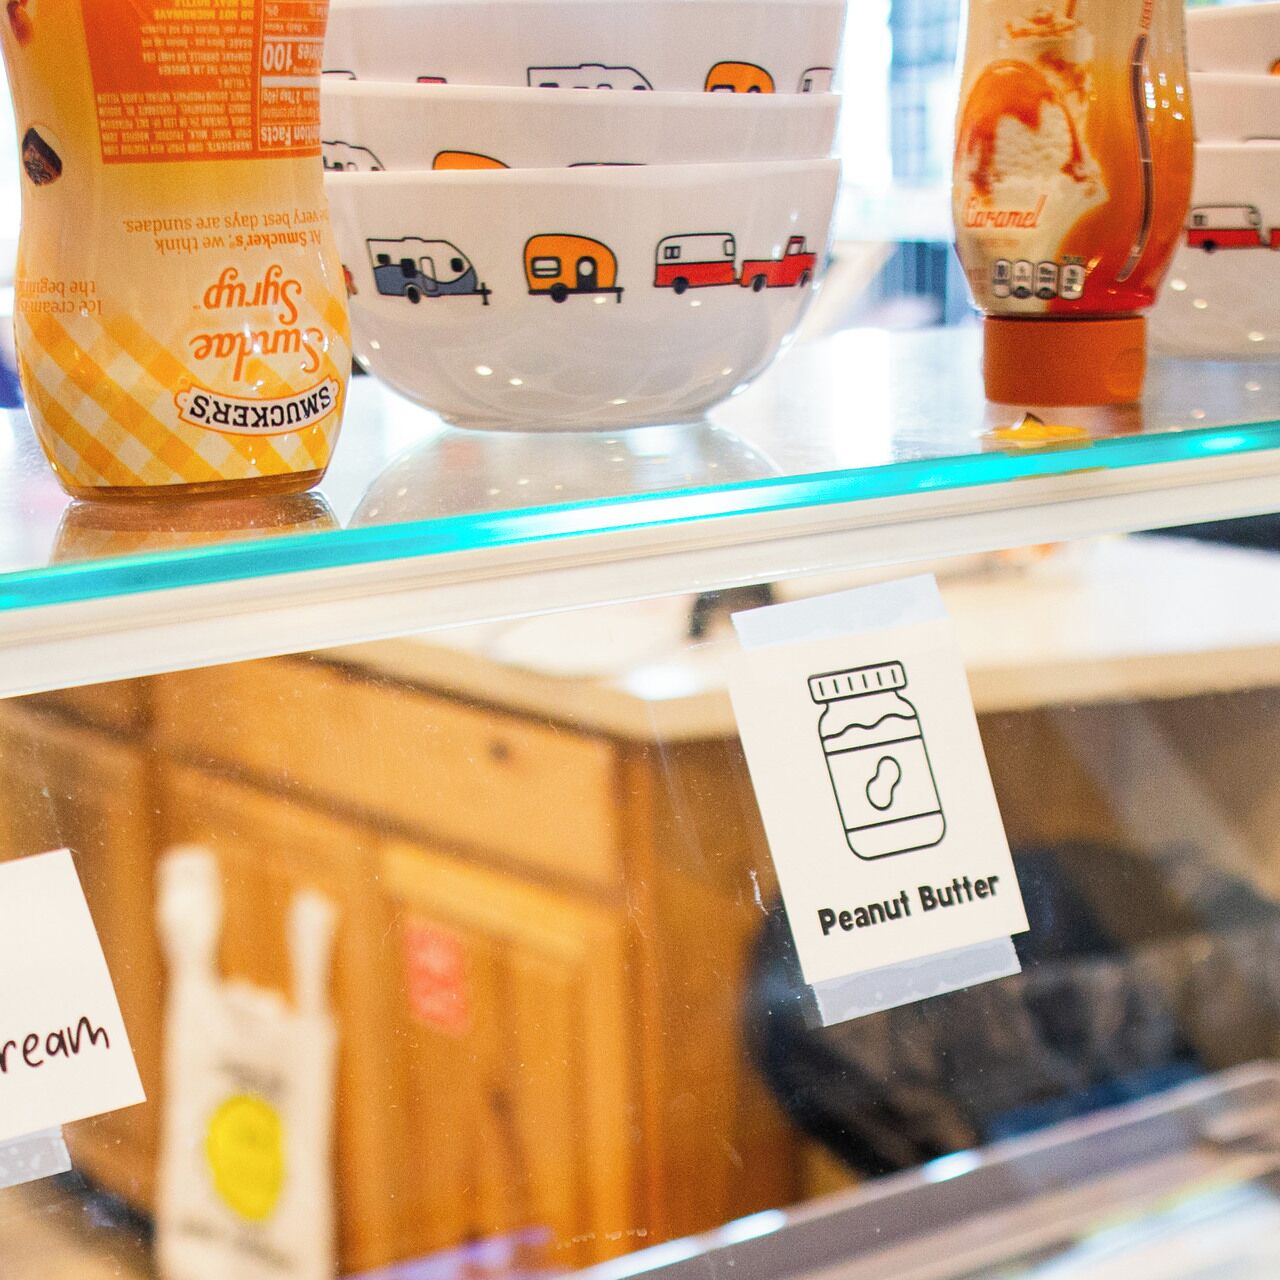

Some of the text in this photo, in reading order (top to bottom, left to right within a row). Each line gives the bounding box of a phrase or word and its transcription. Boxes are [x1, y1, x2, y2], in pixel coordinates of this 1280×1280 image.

[263, 42, 292, 71] 100
[261, 127, 291, 146] Facts
[294, 208, 318, 224] very
[965, 194, 1048, 229] Caramel
[123, 218, 192, 236] sundaes.
[197, 217, 220, 230] are
[223, 210, 259, 232] days
[263, 214, 290, 229] best
[155, 237, 198, 255] think
[202, 235, 224, 248] we
[70, 280, 96, 297] the
[29, 300, 75, 314] cream
[79, 300, 102, 316] Ice
[189, 327, 324, 382] Sundae
[190, 385, 331, 428] SMUCKER'S
[817, 874, 1001, 936] Peanut Butter
